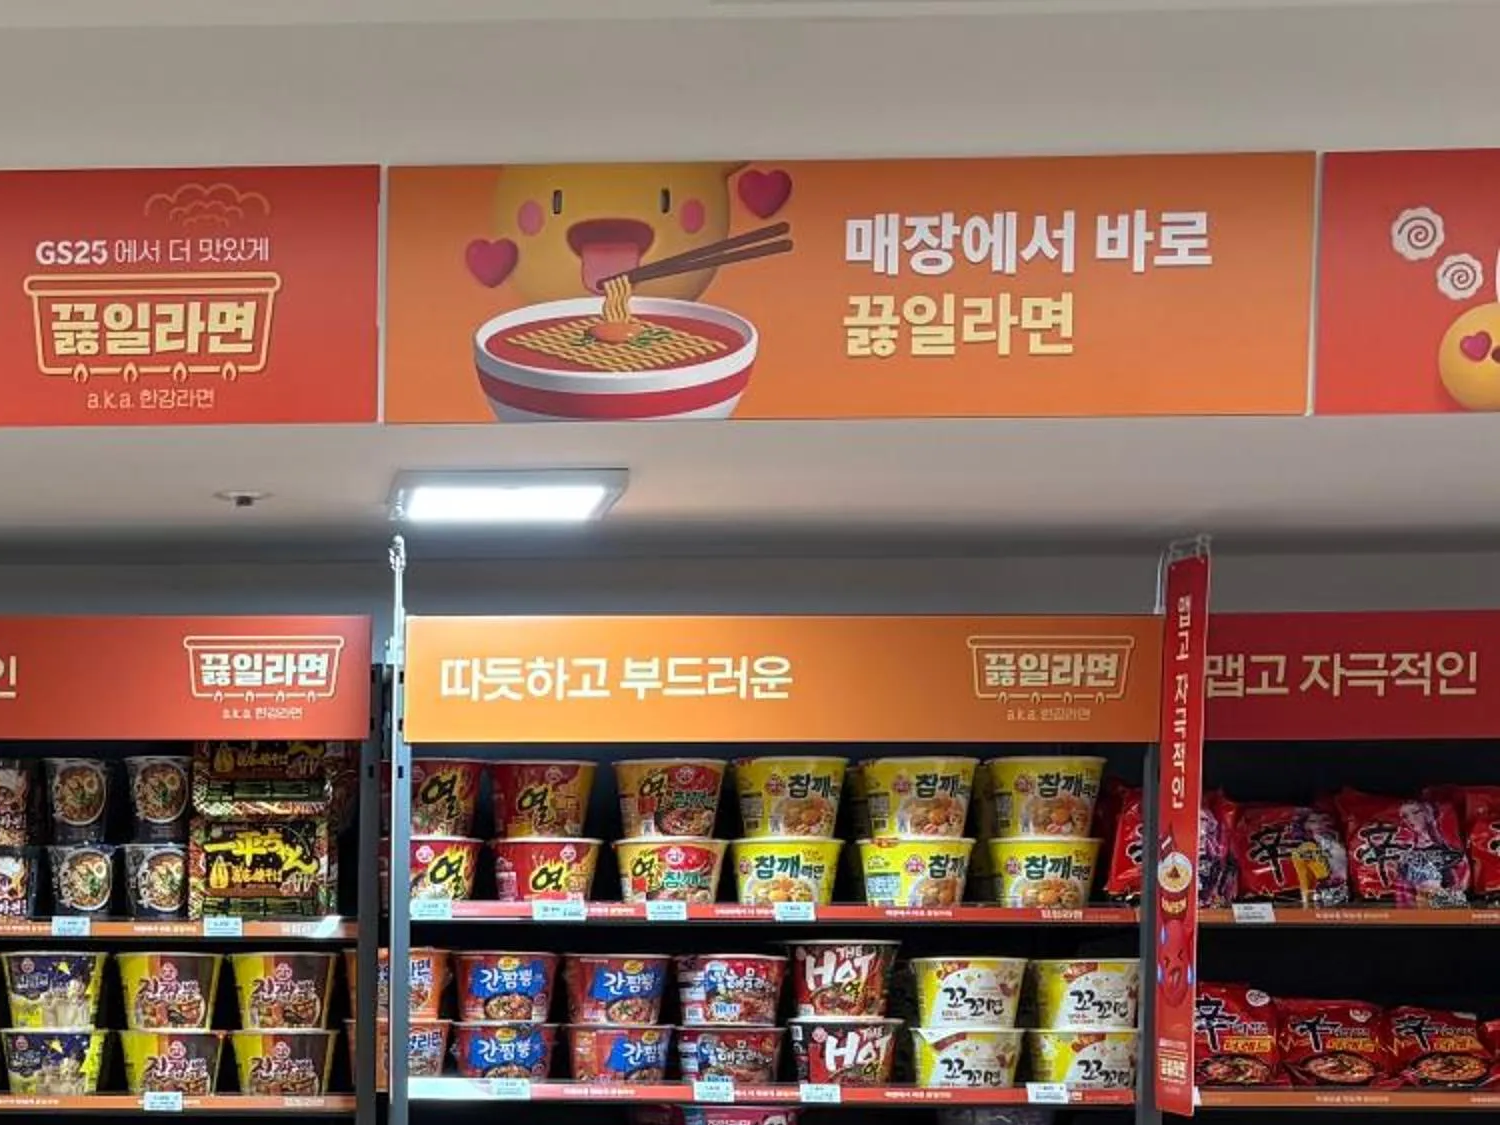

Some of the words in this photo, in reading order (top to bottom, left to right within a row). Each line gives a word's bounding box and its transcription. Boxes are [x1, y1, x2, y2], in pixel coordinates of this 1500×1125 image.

[36, 239, 109, 267] GS25
[115, 239, 161, 265] 에서
[169, 239, 191, 265] 더
[198, 237, 270, 265] 맛있게
[844, 212, 1074, 275] 매장에서
[1096, 211, 1213, 271] 바로
[51, 300, 254, 356] 끓일라면
[844, 293, 1074, 357] 끓일라면
[139, 387, 214, 410] 한강라면
[200, 652, 329, 687] 끓일라면
[440, 656, 610, 701] 따듯하고
[620, 656, 793, 701] 부드러운
[984, 653, 1119, 688] 끓일라면
[1206, 654, 1289, 698] 맵고
[1299, 651, 1478, 697] 자극적인
[1024, 855, 1090, 880] 참깨라면
[804, 952, 874, 992] HOT
[824, 1034, 891, 1072] HOT
